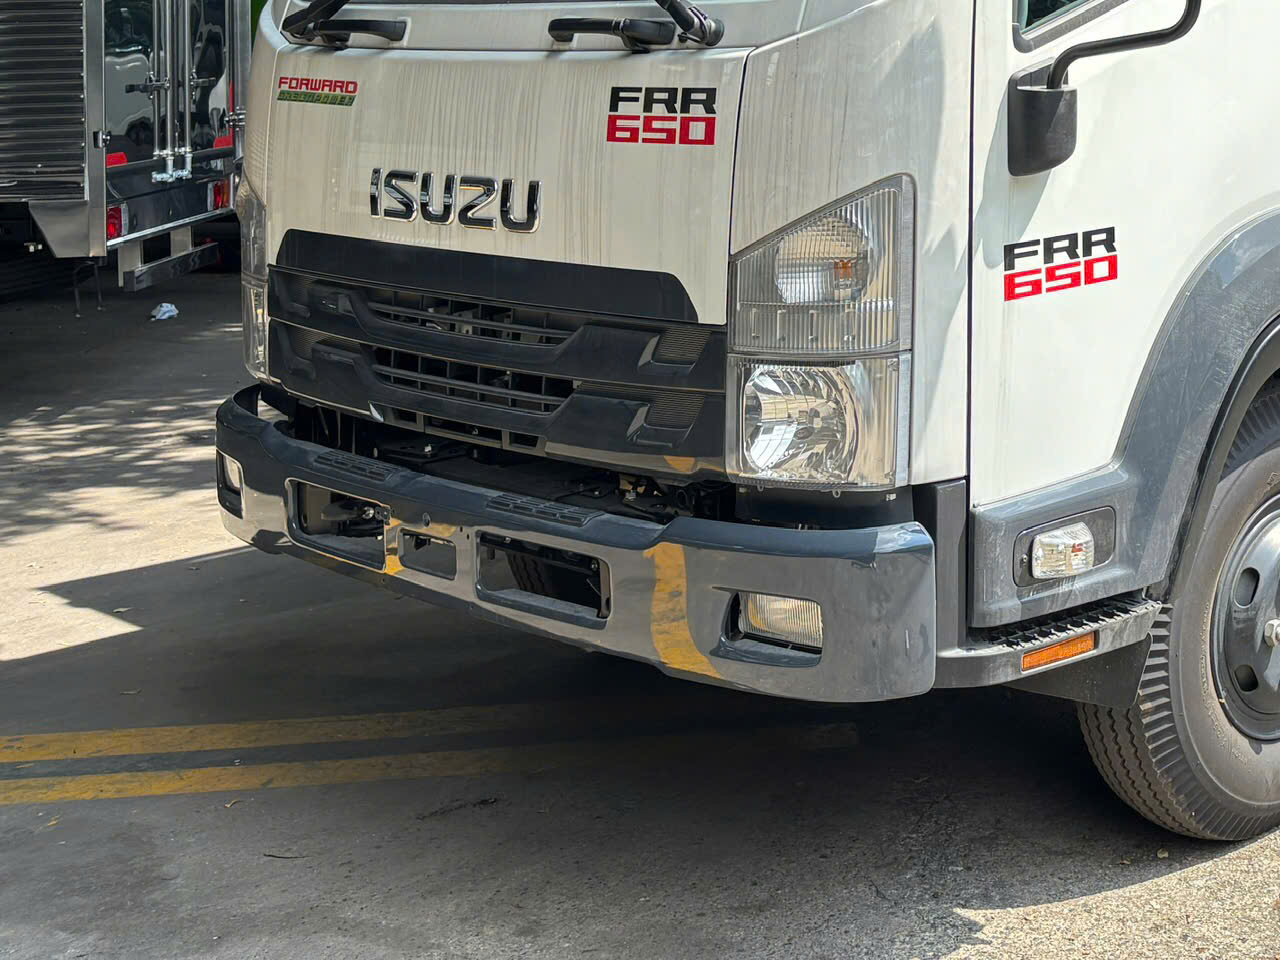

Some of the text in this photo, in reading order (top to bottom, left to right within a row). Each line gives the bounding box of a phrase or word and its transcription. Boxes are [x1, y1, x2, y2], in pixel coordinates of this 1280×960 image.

[278, 77, 358, 94] FORWARD
[608, 86, 717, 115] FRR
[606, 114, 716, 146] 650
[369, 167, 542, 234] ISUZU
[1003, 226, 1117, 271] FRR
[1004, 254, 1118, 302] 650
